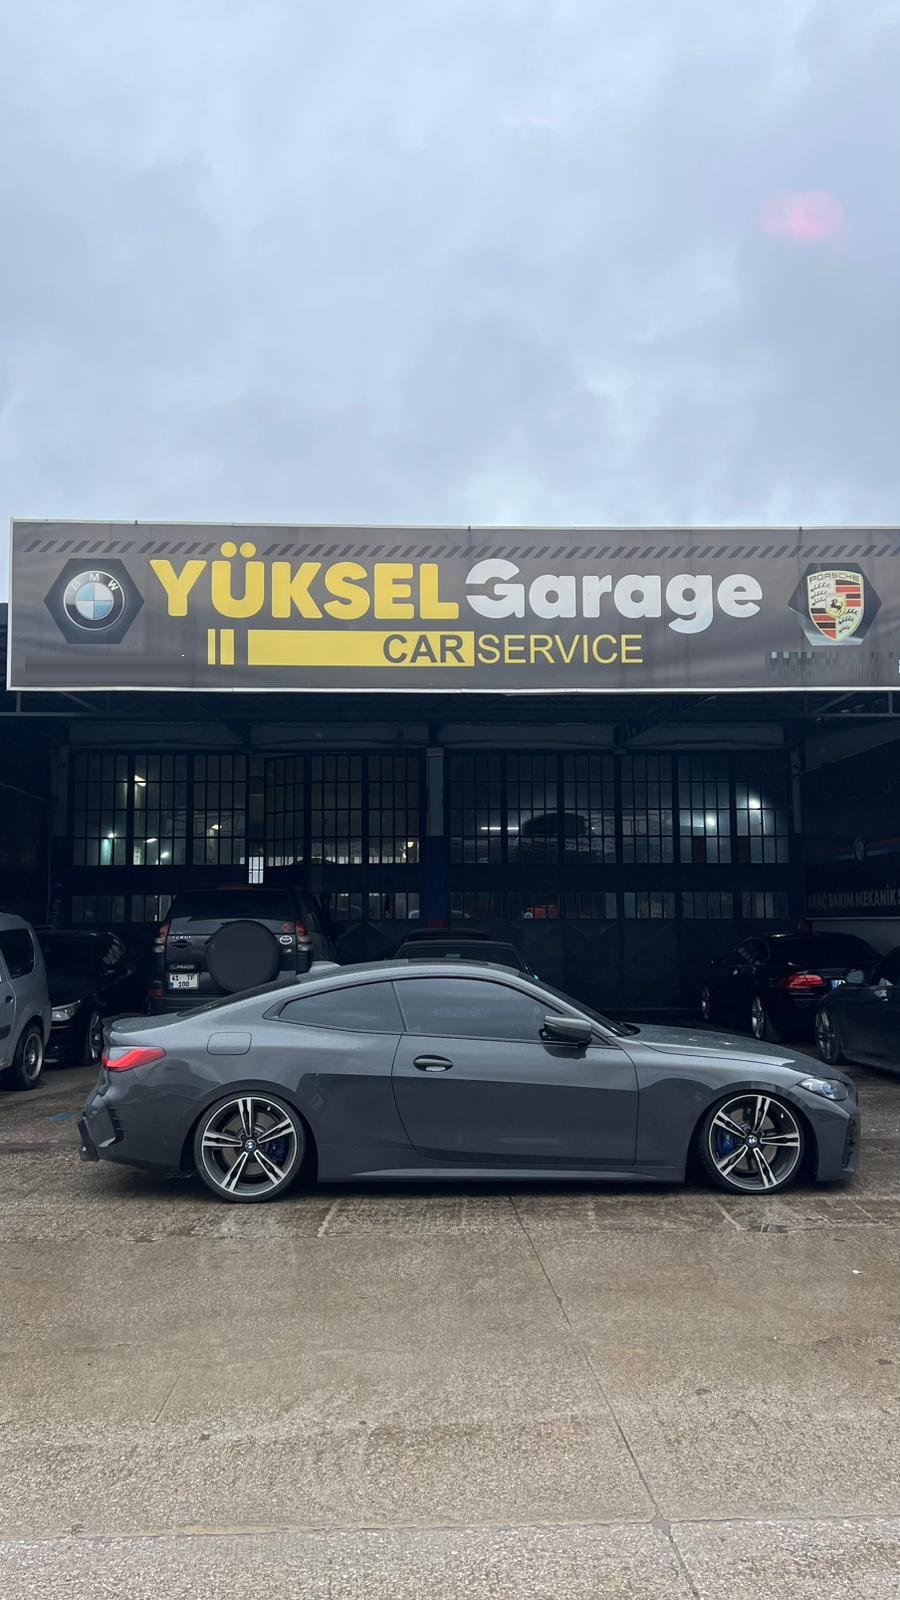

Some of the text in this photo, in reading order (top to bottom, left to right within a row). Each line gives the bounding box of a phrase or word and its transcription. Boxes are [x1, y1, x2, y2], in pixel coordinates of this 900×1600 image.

[71, 573, 119, 591] BMW
[149, 541, 763, 634] YÜKSEL Garage
[809, 572, 860, 582] PORSCHE
[383, 634, 644, 664] CAR SERVICE
[855, 883, 897, 908] MEKANİK
